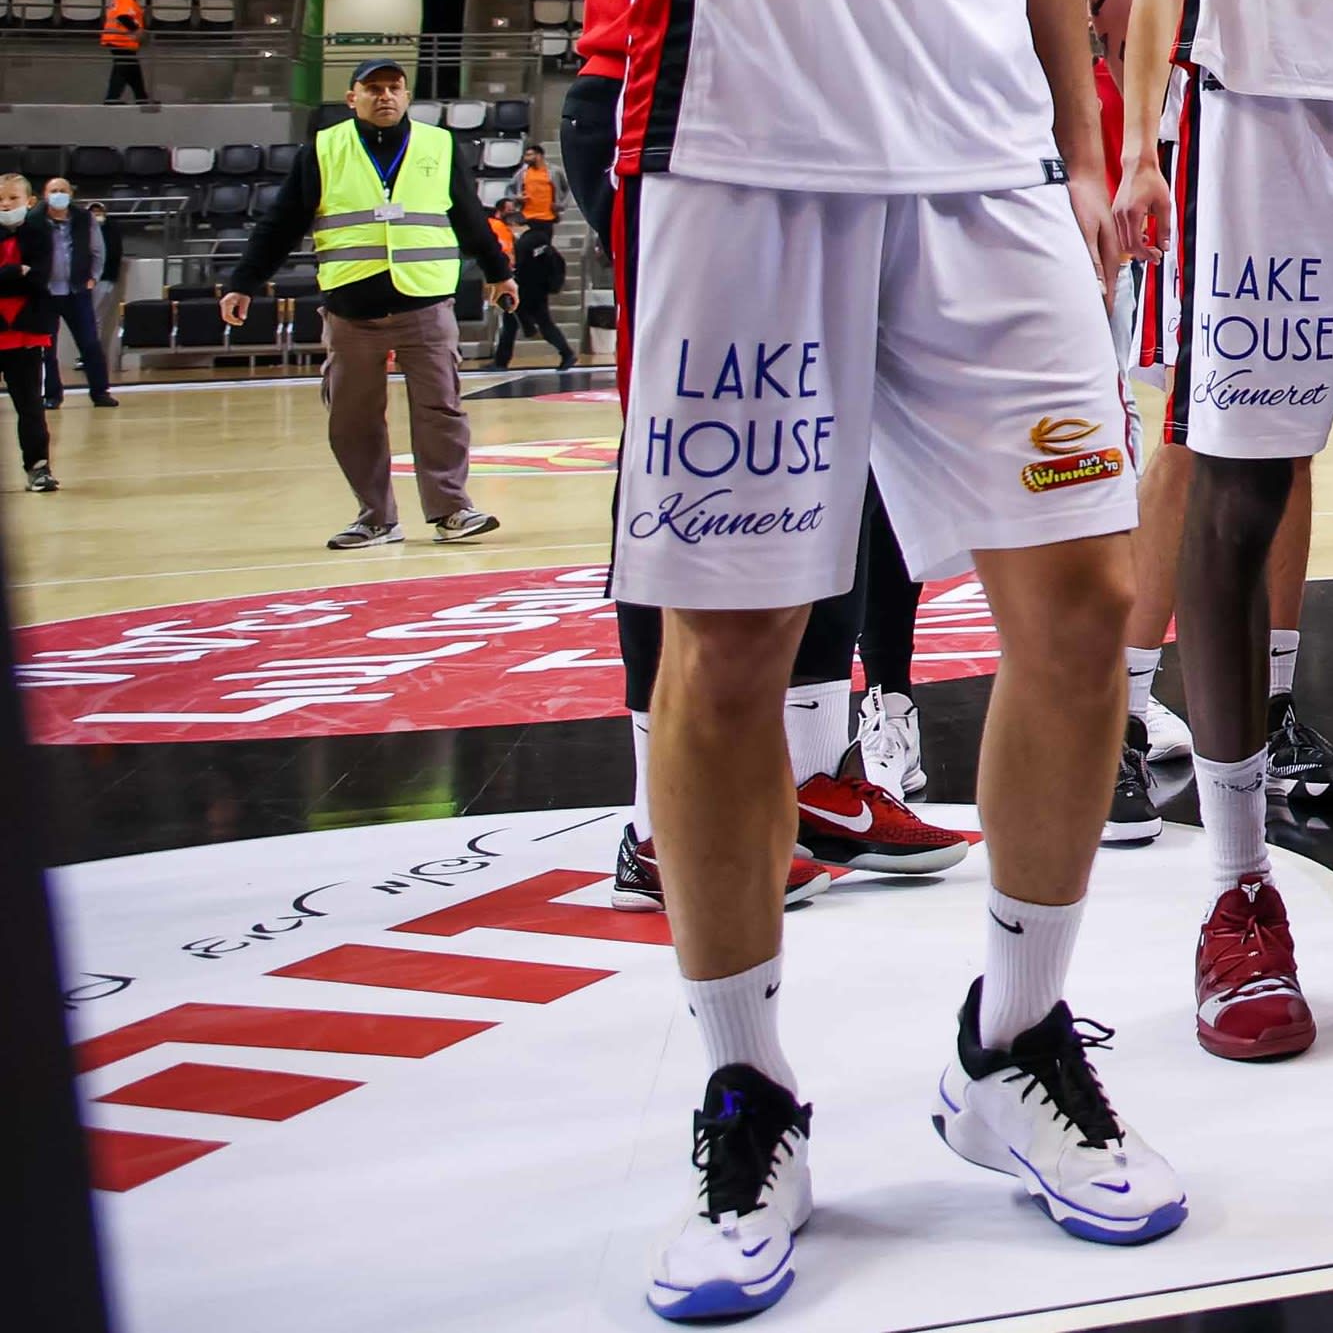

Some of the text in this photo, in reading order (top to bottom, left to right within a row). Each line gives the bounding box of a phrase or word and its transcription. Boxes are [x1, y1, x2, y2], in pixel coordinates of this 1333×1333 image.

[1211, 252, 1322, 302] LAKE
[676, 338, 820, 400] LAKE
[1194, 369, 1330, 410] Kinneret
[646, 415, 835, 478] HOUSE
[1104, 461, 1119, 472] סל
[1034, 464, 1104, 487] Winner
[630, 488, 825, 545] Kinneret
